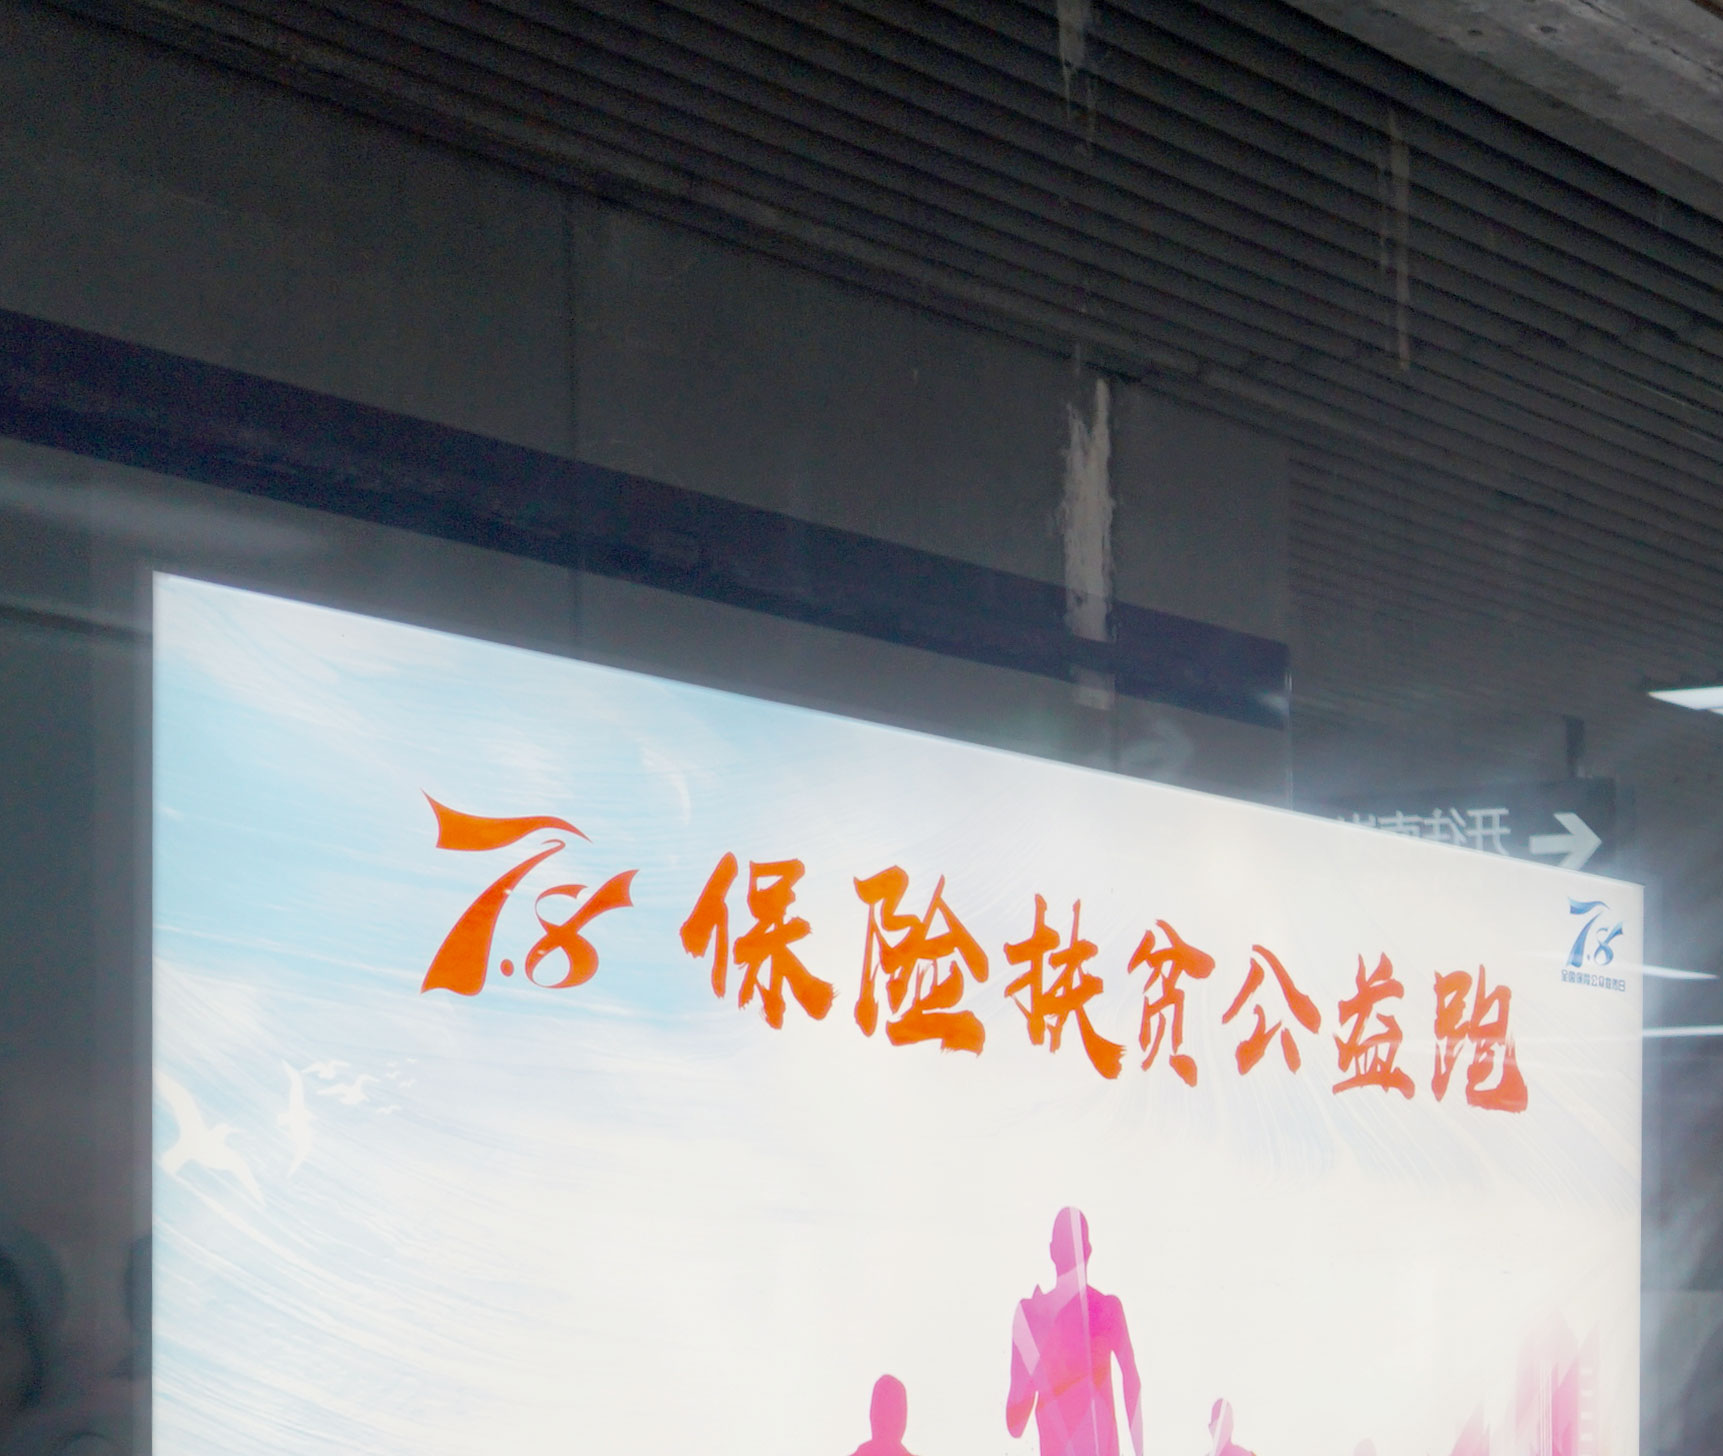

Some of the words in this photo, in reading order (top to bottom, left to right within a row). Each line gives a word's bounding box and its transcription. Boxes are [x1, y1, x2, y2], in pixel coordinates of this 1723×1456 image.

[679, 850, 1529, 1114] 保险扶贫公益跑
